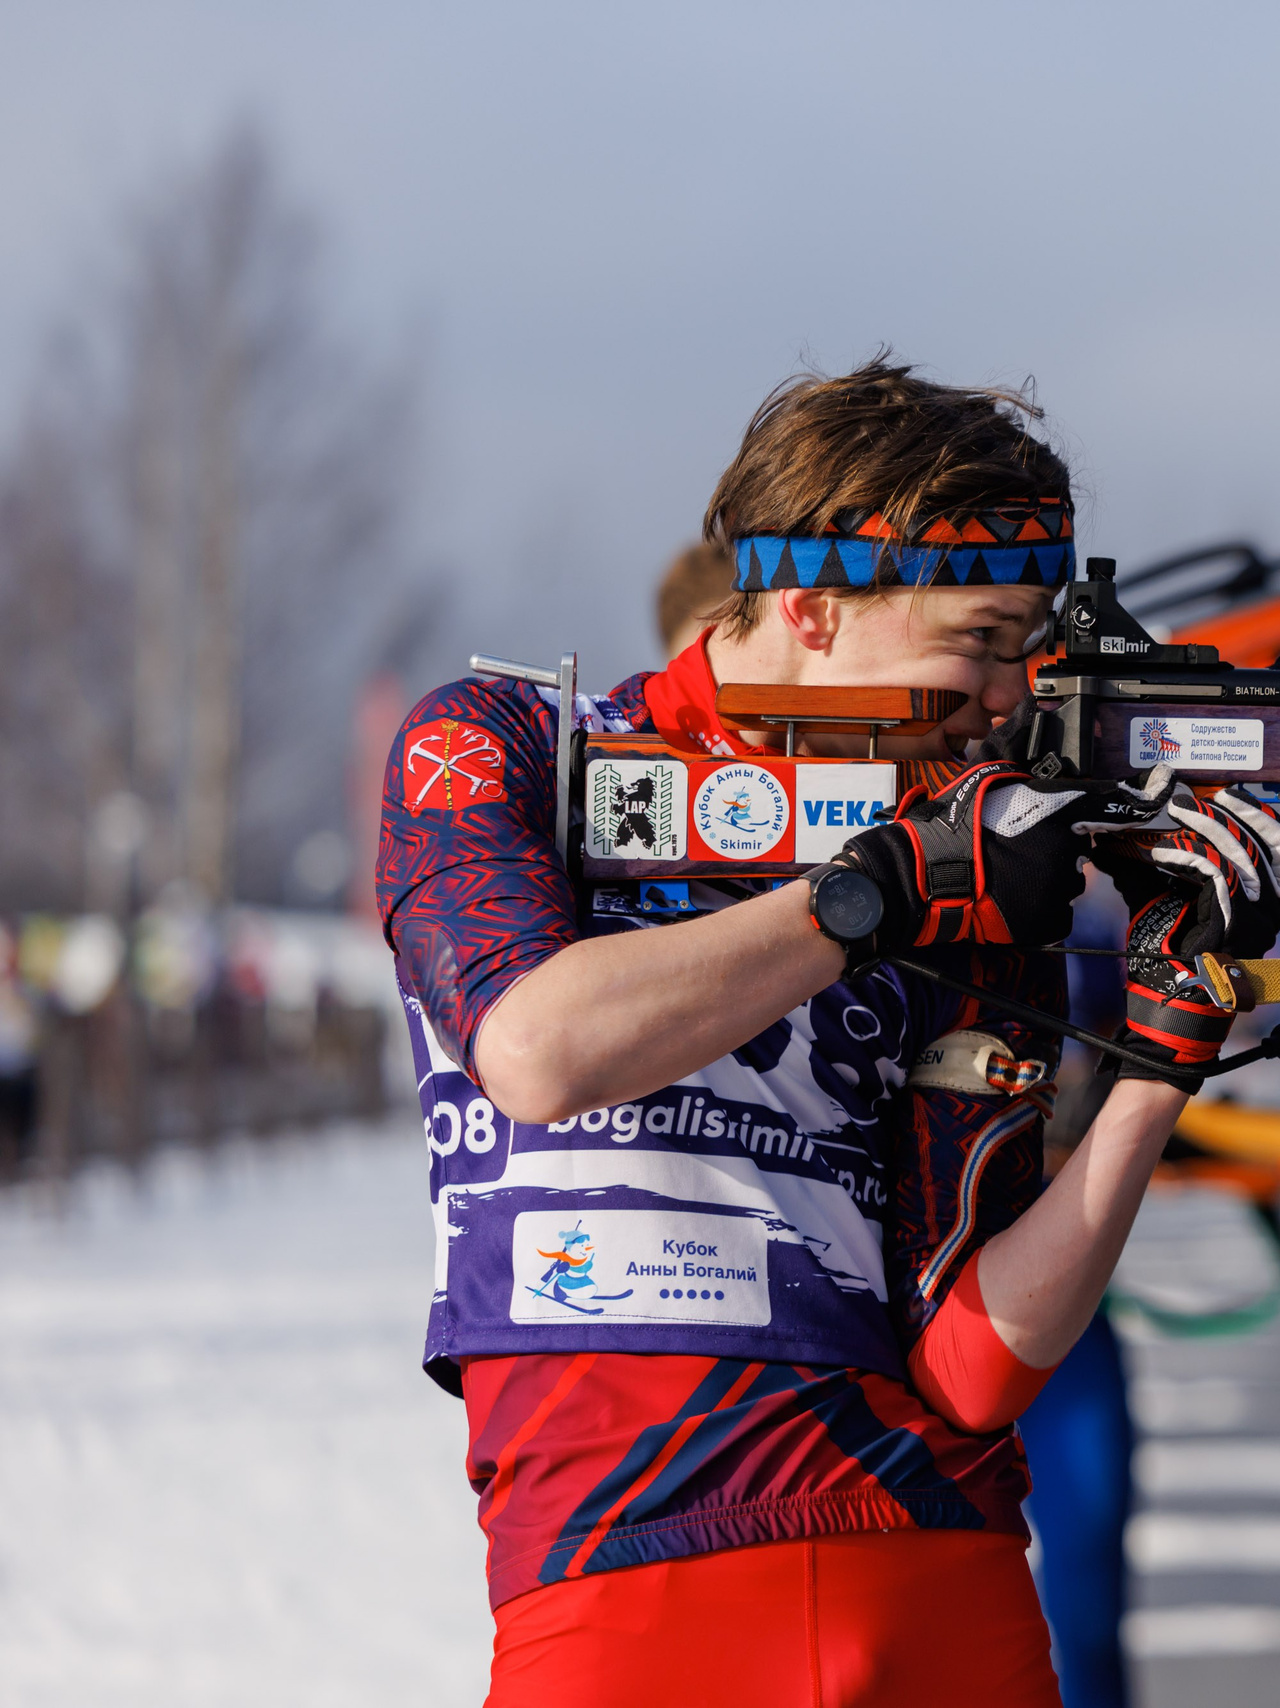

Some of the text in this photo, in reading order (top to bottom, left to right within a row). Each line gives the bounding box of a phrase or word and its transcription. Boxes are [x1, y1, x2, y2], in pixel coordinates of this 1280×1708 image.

[1102, 637, 1150, 653] skimir
[1190, 723, 1237, 736] Содружество
[1190, 738, 1260, 749] детско-юношеского
[1190, 751, 1247, 762] биатлона России
[955, 764, 1000, 802] EasySki
[624, 800, 647, 814] LAP
[698, 769, 784, 832] Кубок Анны Богалий
[803, 800, 889, 826] VEKA
[720, 839, 763, 850] Skimir
[662, 1239, 718, 1259] Кубок
[626, 1261, 757, 1282] Анны Богалий
